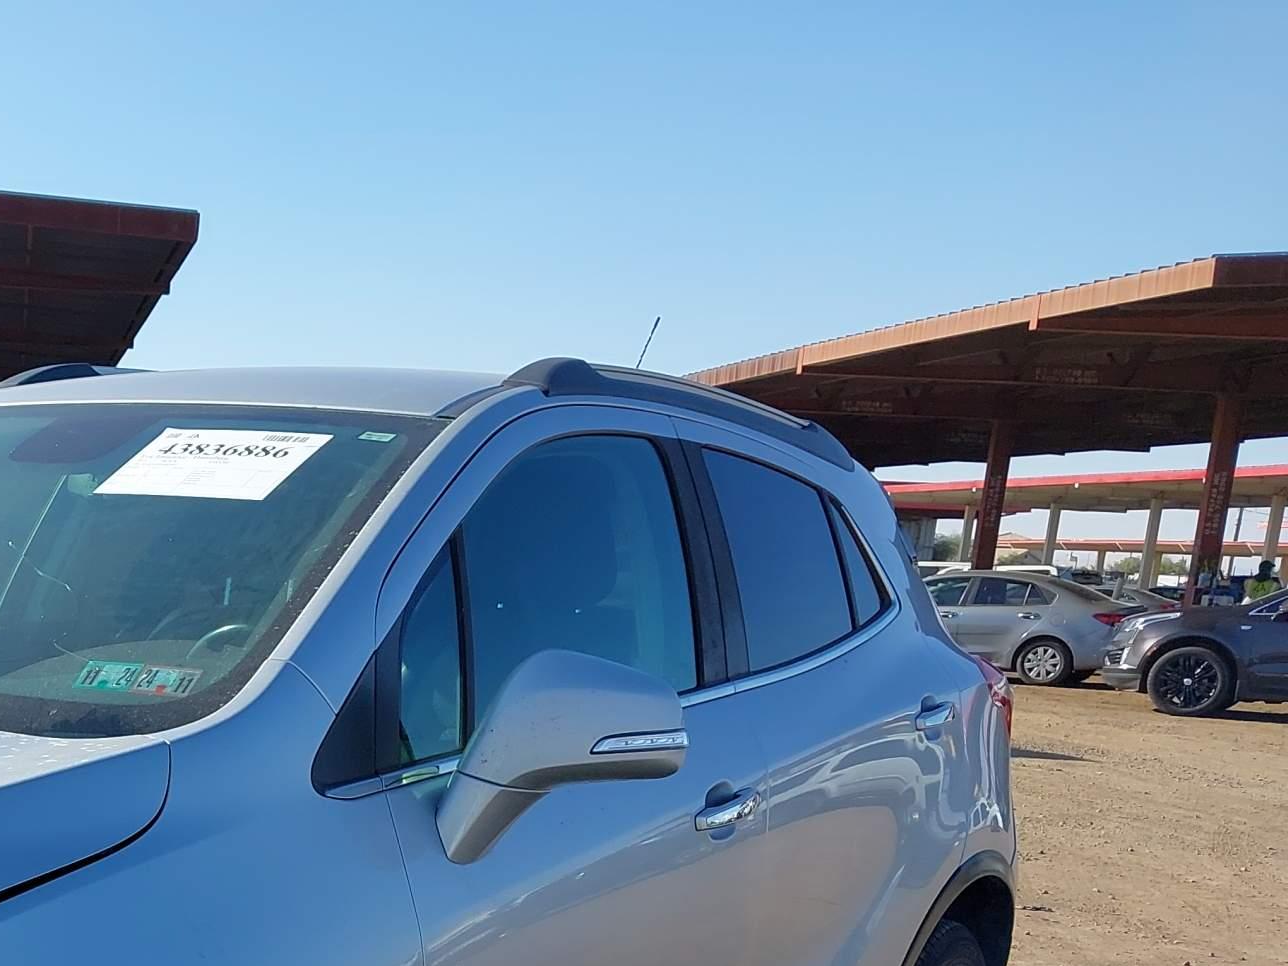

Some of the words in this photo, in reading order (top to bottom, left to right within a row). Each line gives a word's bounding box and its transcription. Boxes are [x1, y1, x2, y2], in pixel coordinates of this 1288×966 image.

[158, 442, 294, 459] 43836886
[81, 669, 101, 686] 11
[115, 668, 138, 687] 24
[137, 669, 160, 689] 24
[174, 677, 195, 694] 11
